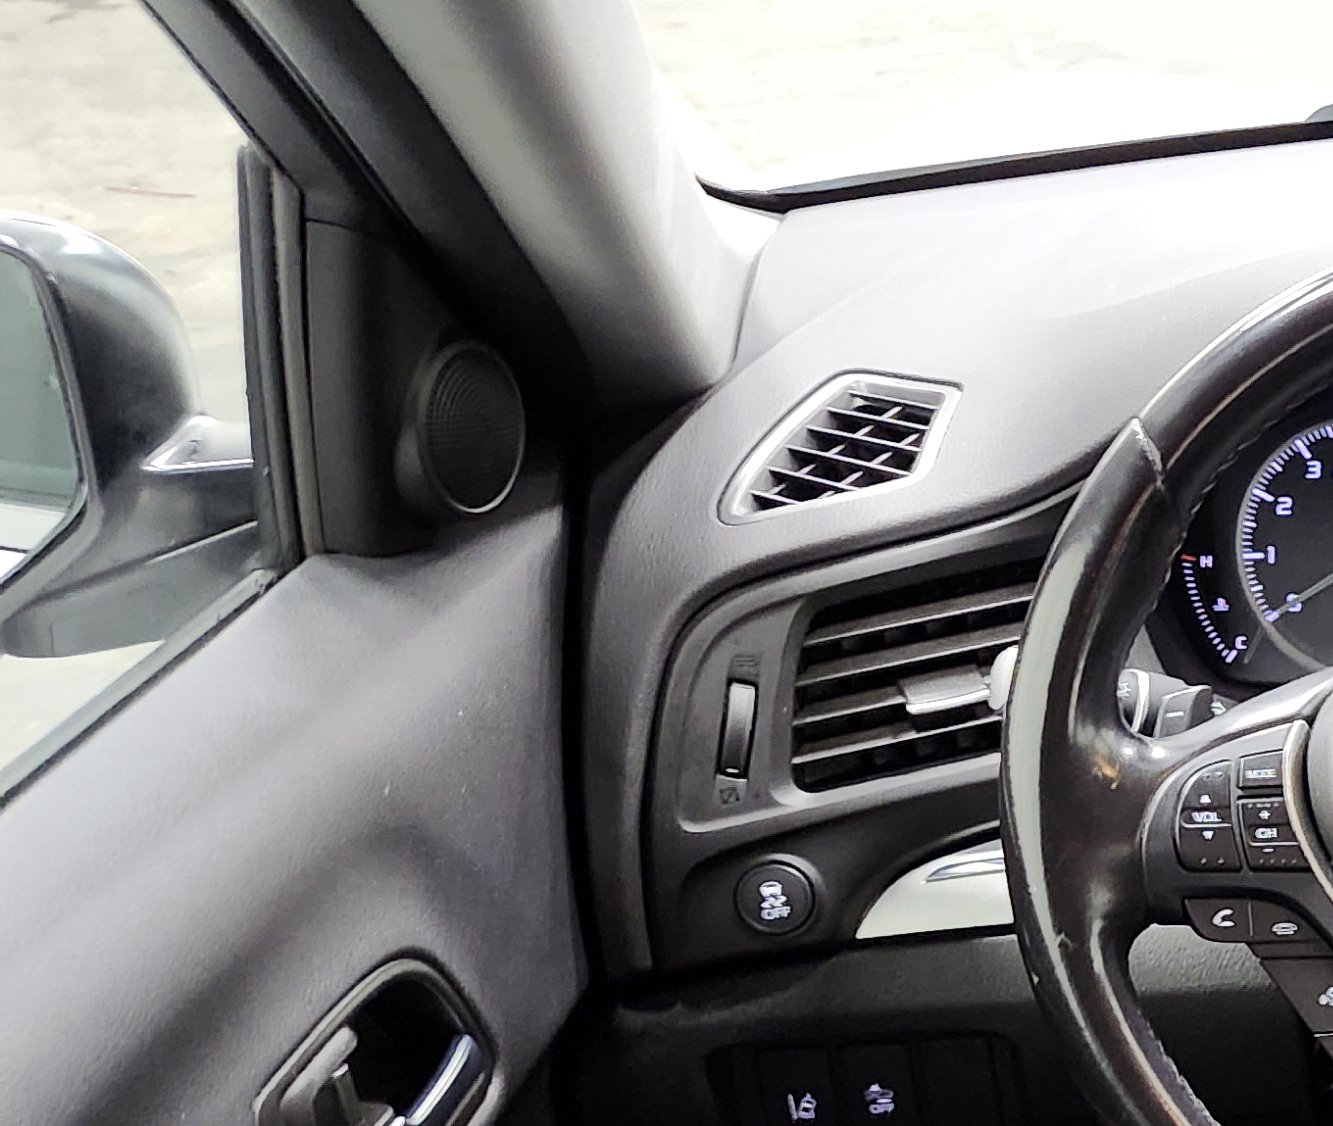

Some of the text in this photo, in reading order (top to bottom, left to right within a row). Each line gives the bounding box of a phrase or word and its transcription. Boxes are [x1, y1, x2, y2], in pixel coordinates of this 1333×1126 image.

[1305, 460, 1322, 479] 3
[1275, 498, 1293, 516] 2
[1200, 555, 1213, 569] H
[1266, 546, 1276, 564] 1
[1235, 636, 1248, 650] C
[1190, 810, 1223, 823] VOL
[1254, 826, 1278, 840] CH
[760, 906, 791, 920] OFF
